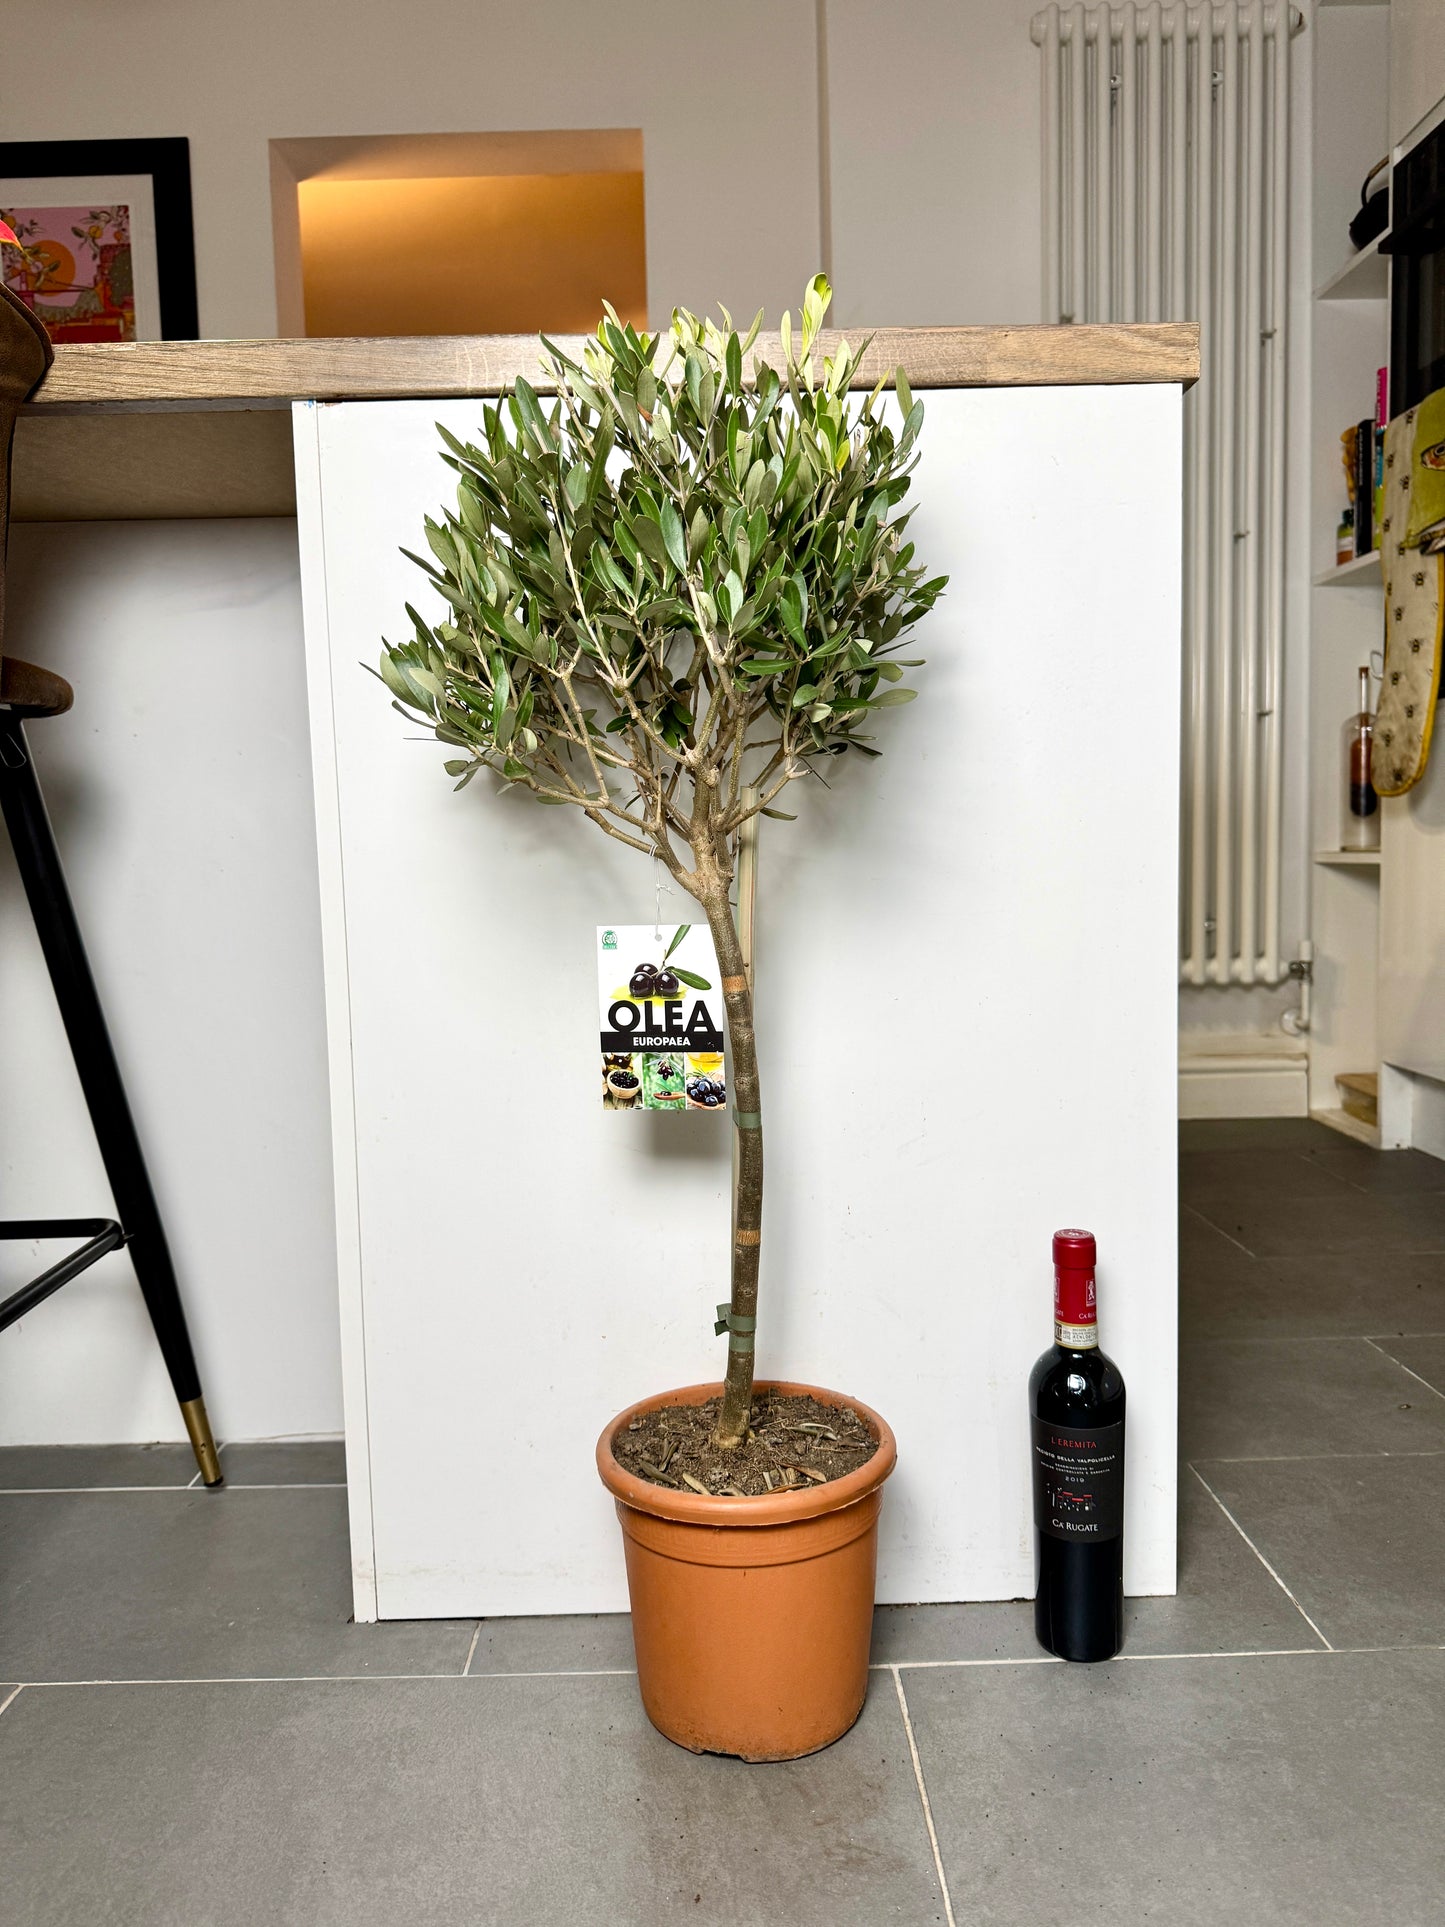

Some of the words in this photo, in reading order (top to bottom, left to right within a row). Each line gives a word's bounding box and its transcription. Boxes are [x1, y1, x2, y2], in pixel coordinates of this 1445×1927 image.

[608, 1000, 717, 1033] OLEA
[633, 1036, 691, 1047] EUROPAEA
[1077, 1454, 1115, 1464] VALPOLICELLA
[1066, 1522, 1099, 1532] RUGATE
